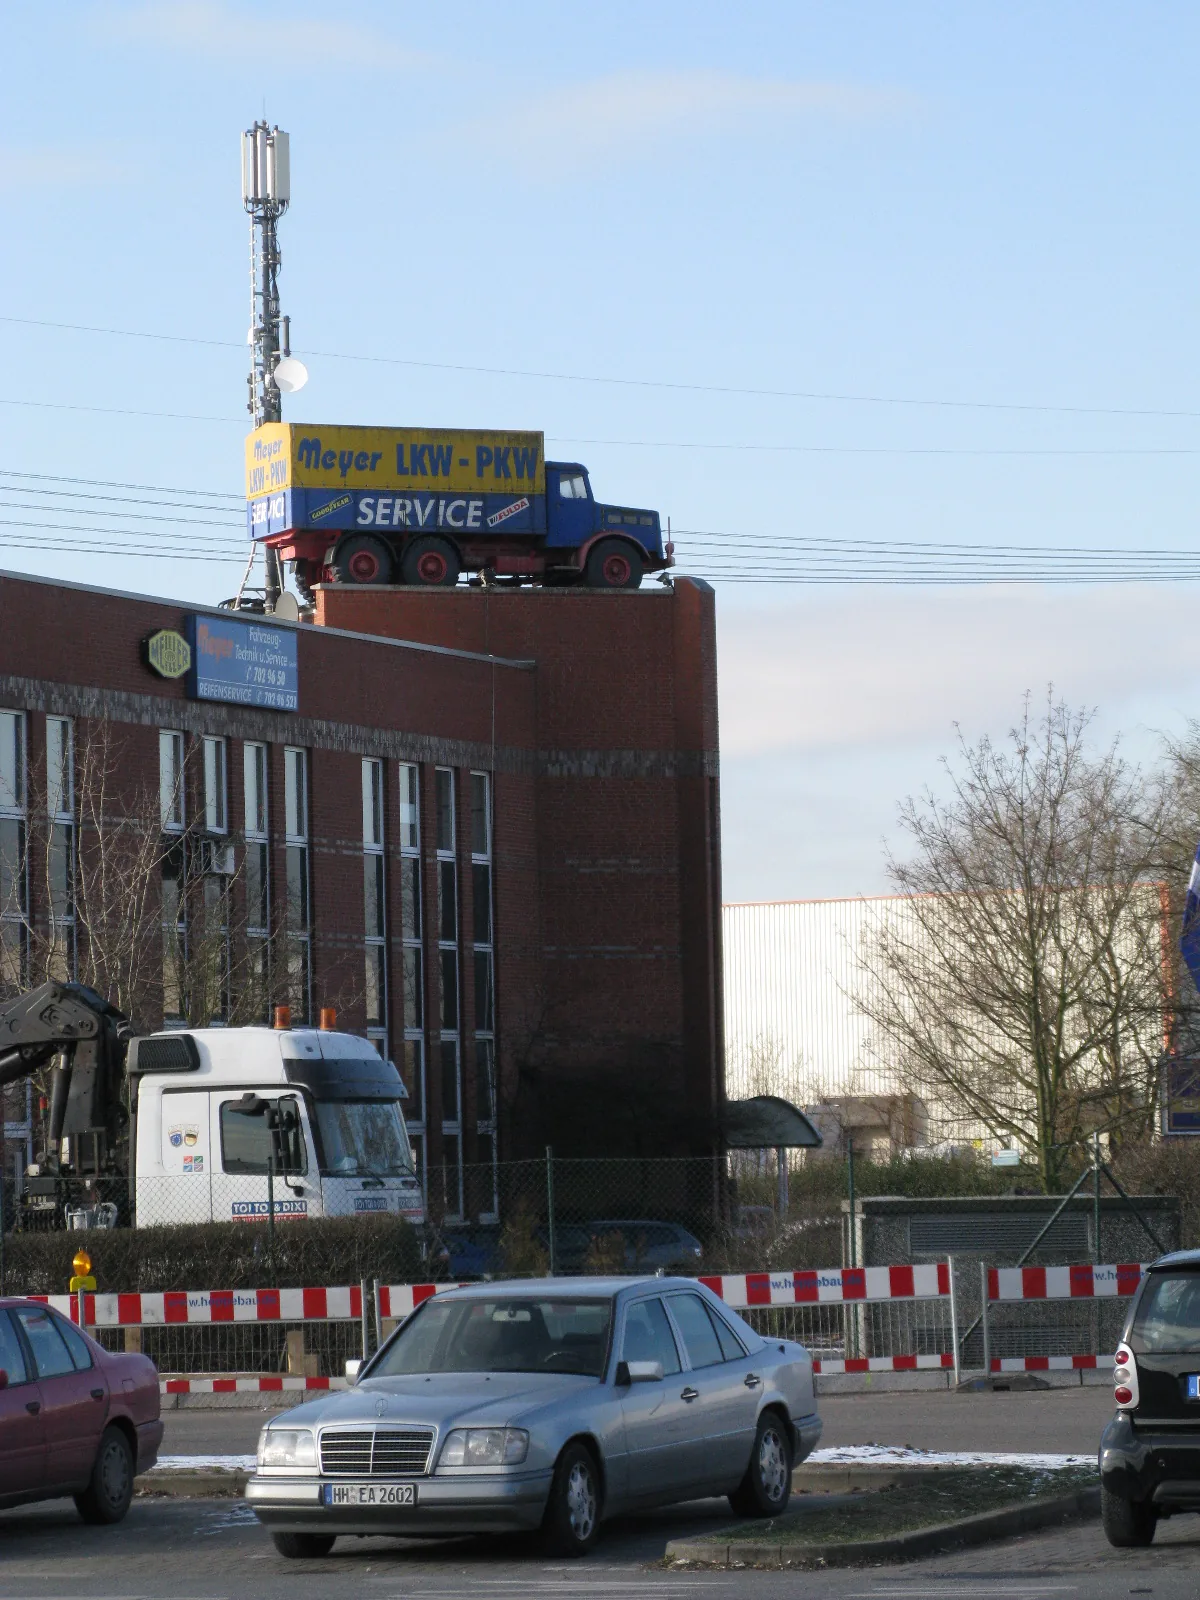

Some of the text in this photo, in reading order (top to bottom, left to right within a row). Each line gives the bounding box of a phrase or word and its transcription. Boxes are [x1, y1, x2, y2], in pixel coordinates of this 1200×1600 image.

[254, 439, 283, 462] Meyer
[297, 436, 383, 478] Meyer
[396, 443, 453, 477] LKW
[476, 445, 539, 479] PKW
[249, 465, 265, 494] LKW
[270, 458, 287, 487] PKW
[311, 496, 350, 520] GOODYEAR
[356, 496, 484, 527] SERVICE
[497, 499, 528, 521] FULDA
[233, 1203, 251, 1214] TOI
[253, 1203, 269, 1213] TO
[282, 1202, 306, 1212] DIXI
[380, 1487, 413, 1503] 2602
